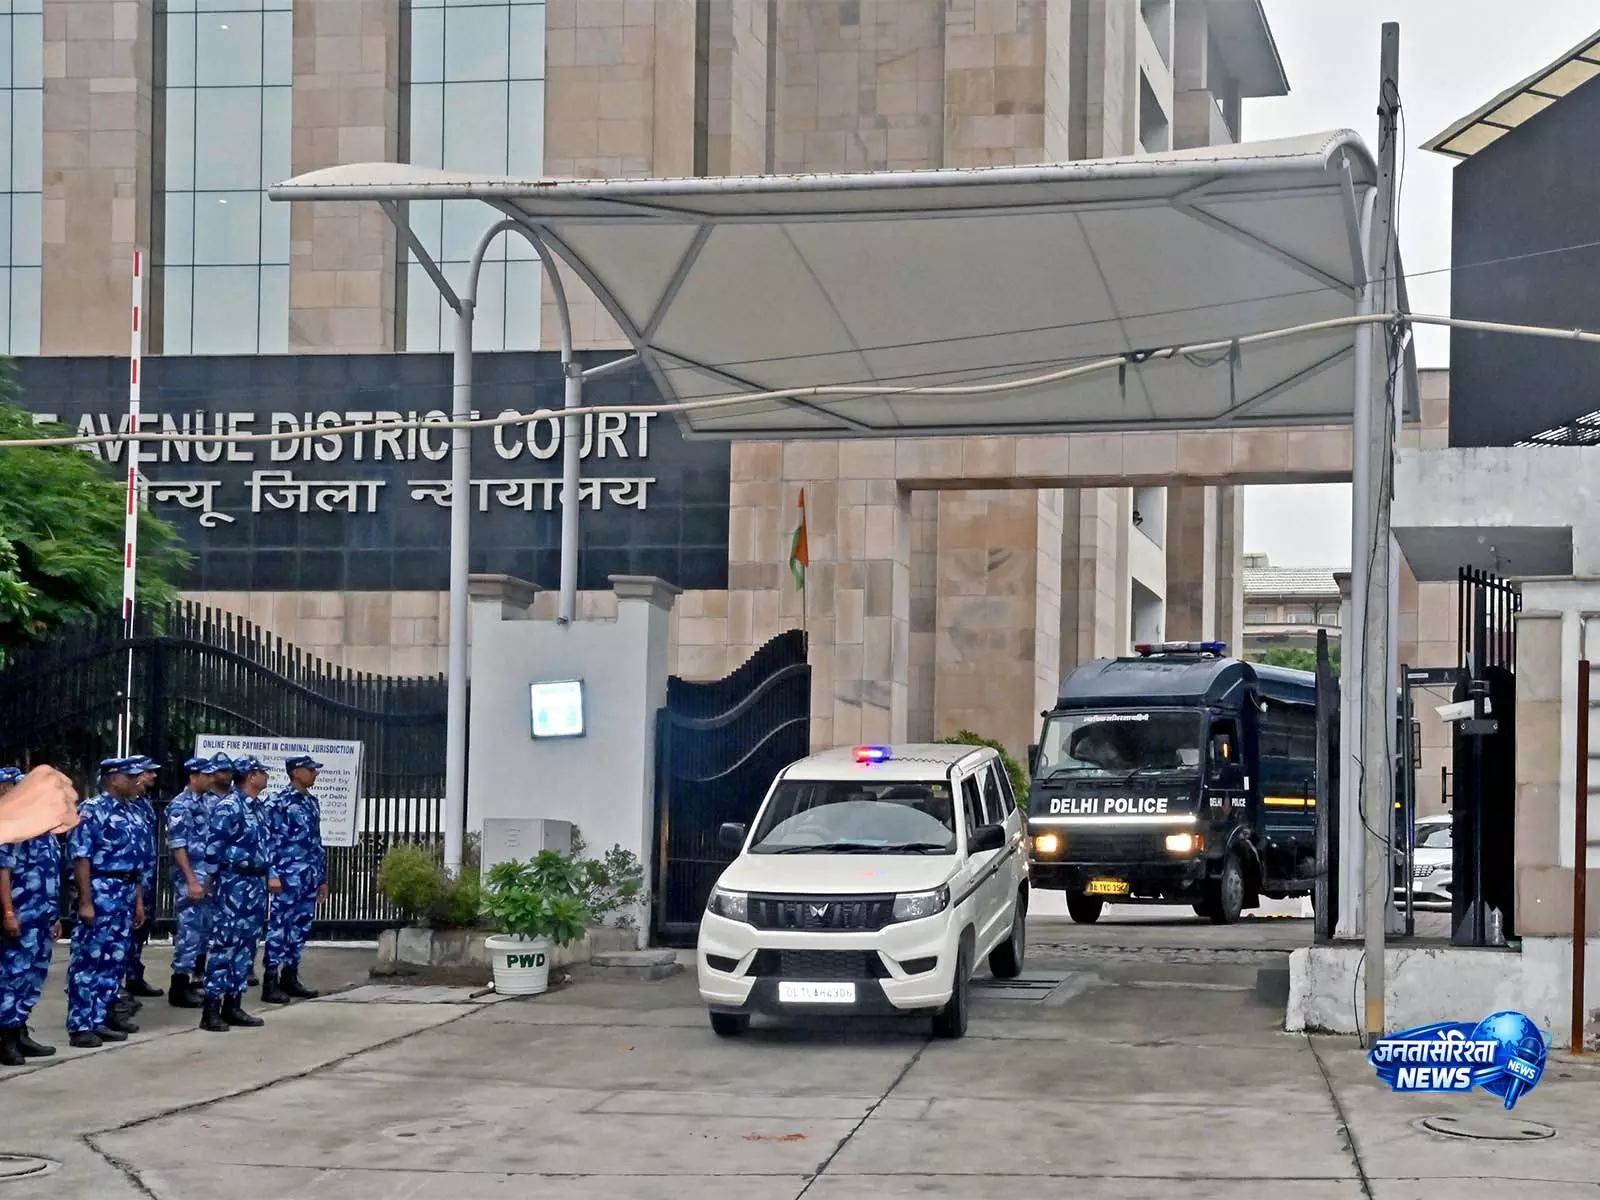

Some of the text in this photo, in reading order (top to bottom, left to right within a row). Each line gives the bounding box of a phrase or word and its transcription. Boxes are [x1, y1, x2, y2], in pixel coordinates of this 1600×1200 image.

[76, 412, 255, 462] AVENUE
[270, 410, 480, 461] DISTRIC
[244, 470, 386, 513] जिला
[203, 739, 355, 755] ONLINE FINE PAYMENT IN CRIMINAL JURISDICTION
[1050, 798, 1168, 814] DELHI POLICE
[1209, 797, 1246, 808] DELHI POLICE
[506, 953, 545, 968] PWD
